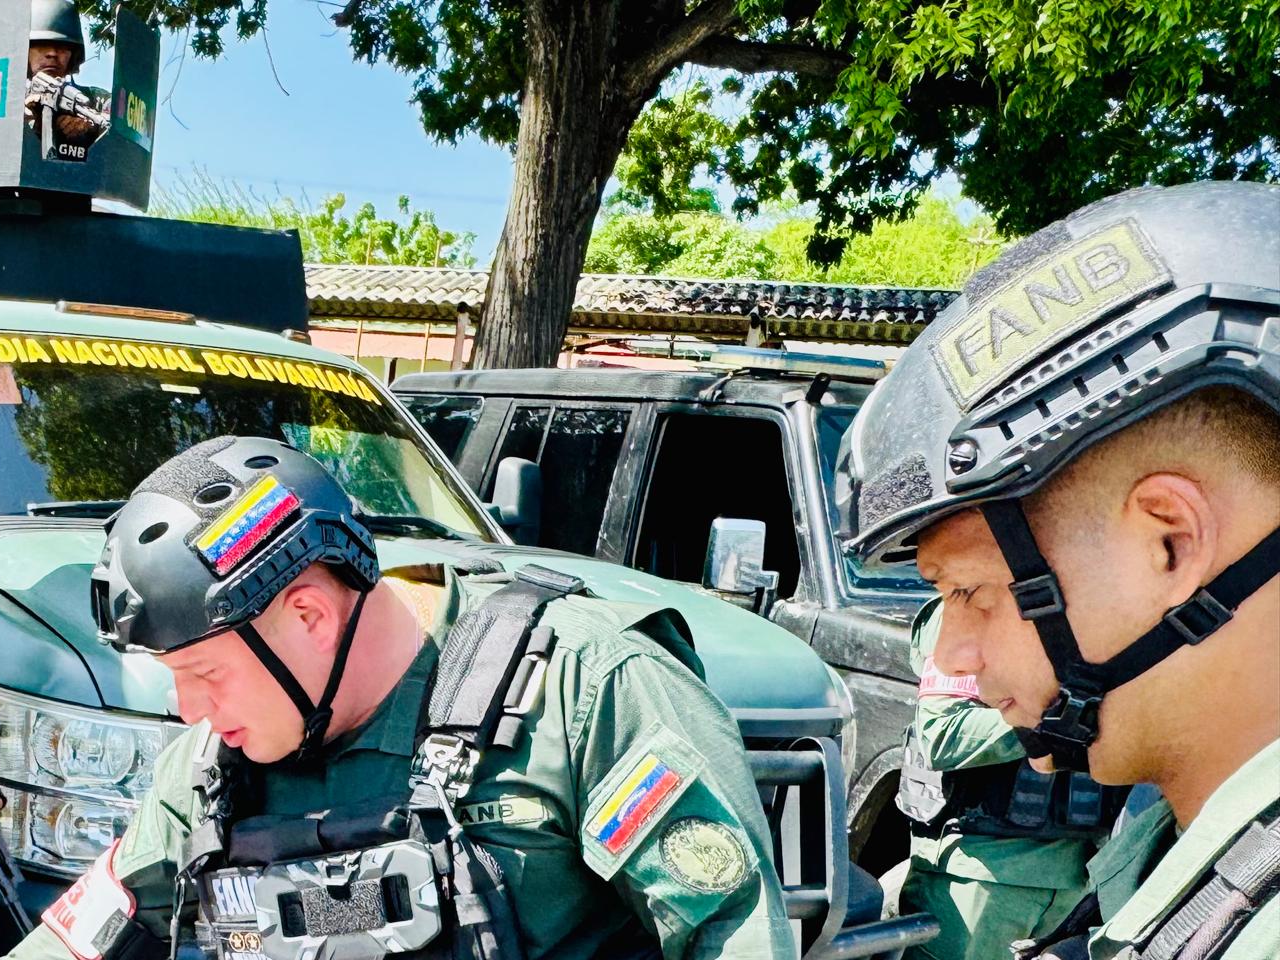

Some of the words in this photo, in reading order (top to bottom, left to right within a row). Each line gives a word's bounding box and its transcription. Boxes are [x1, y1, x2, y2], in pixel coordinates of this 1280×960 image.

[58, 143, 86, 159] GNB
[954, 242, 1132, 379] FANB
[52, 339, 205, 374] NACIONAL
[205, 351, 382, 406] BOLIVARIANA
